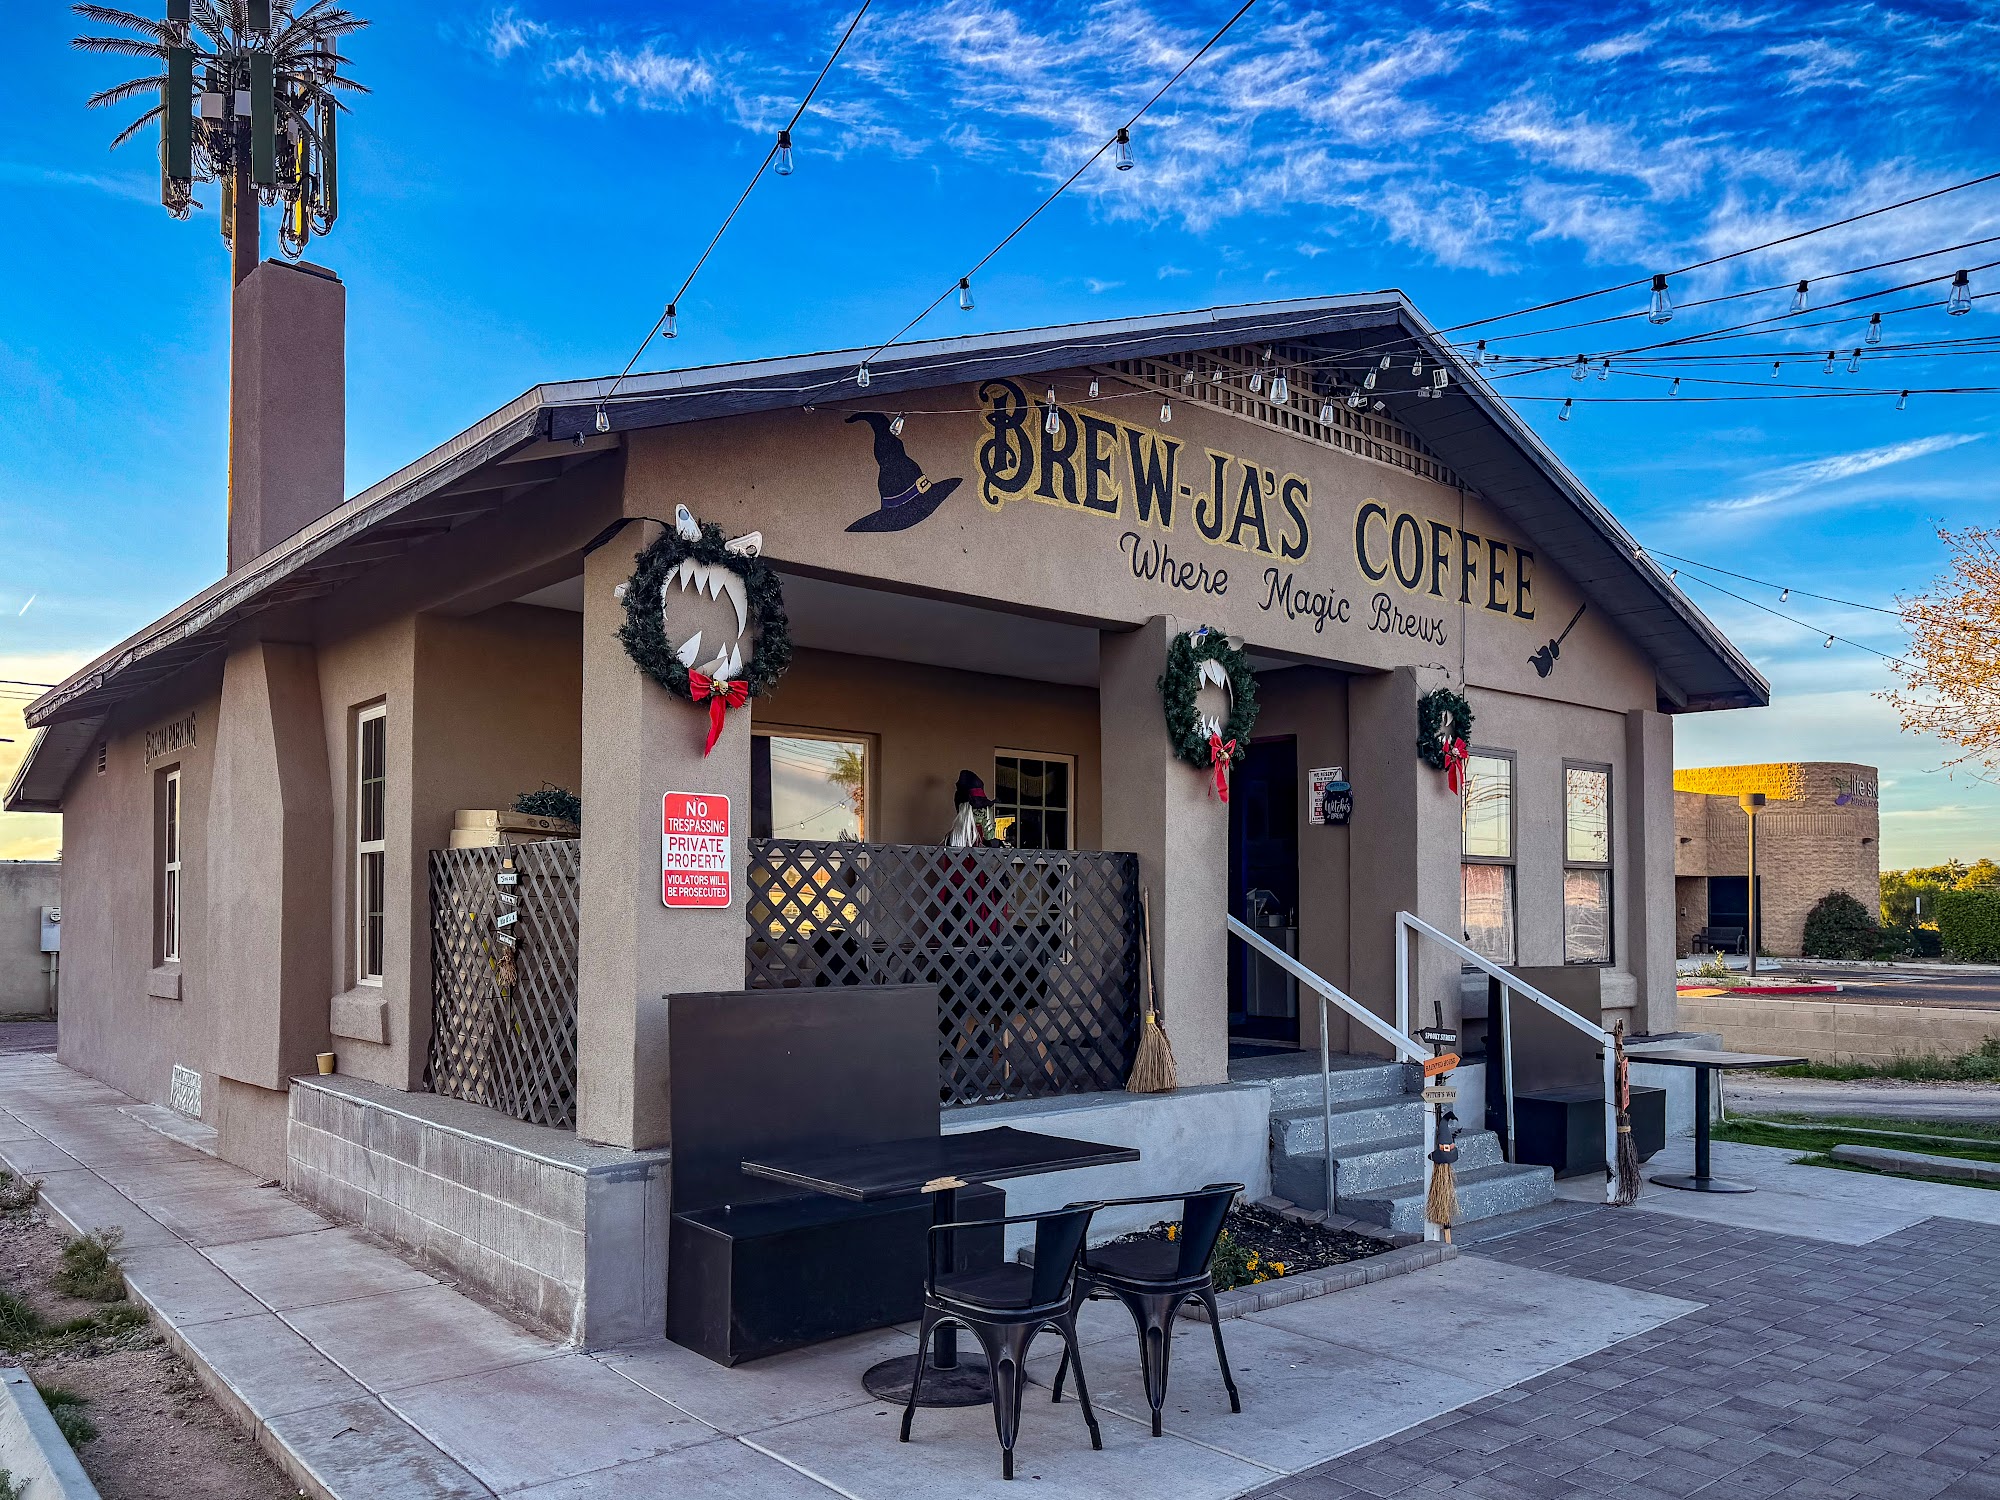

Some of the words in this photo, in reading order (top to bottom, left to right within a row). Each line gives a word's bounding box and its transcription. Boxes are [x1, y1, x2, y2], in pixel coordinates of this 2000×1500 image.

[978, 378, 1311, 562] BREW-JA'S
[1354, 498, 1537, 622] COFFEE
[1119, 531, 1229, 596] Where
[1258, 567, 1351, 634] Magic
[1367, 592, 1448, 647] Brews
[168, 710, 197, 753] PARKING
[1851, 773, 1866, 796] life
[686, 801, 708, 817] NO
[668, 818, 725, 833] TRESPASSING
[669, 836, 724, 853] PRIVATE
[667, 852, 726, 869] PROPERTY
[667, 874, 710, 885] VIOLATORS
[710, 875, 727, 886] WILL
[667, 886, 678, 897] BE
[678, 886, 727, 898] PROSECUTED
[1425, 1032, 1440, 1040] SPOOKY
[1425, 1061, 1443, 1071] HAUNTED
